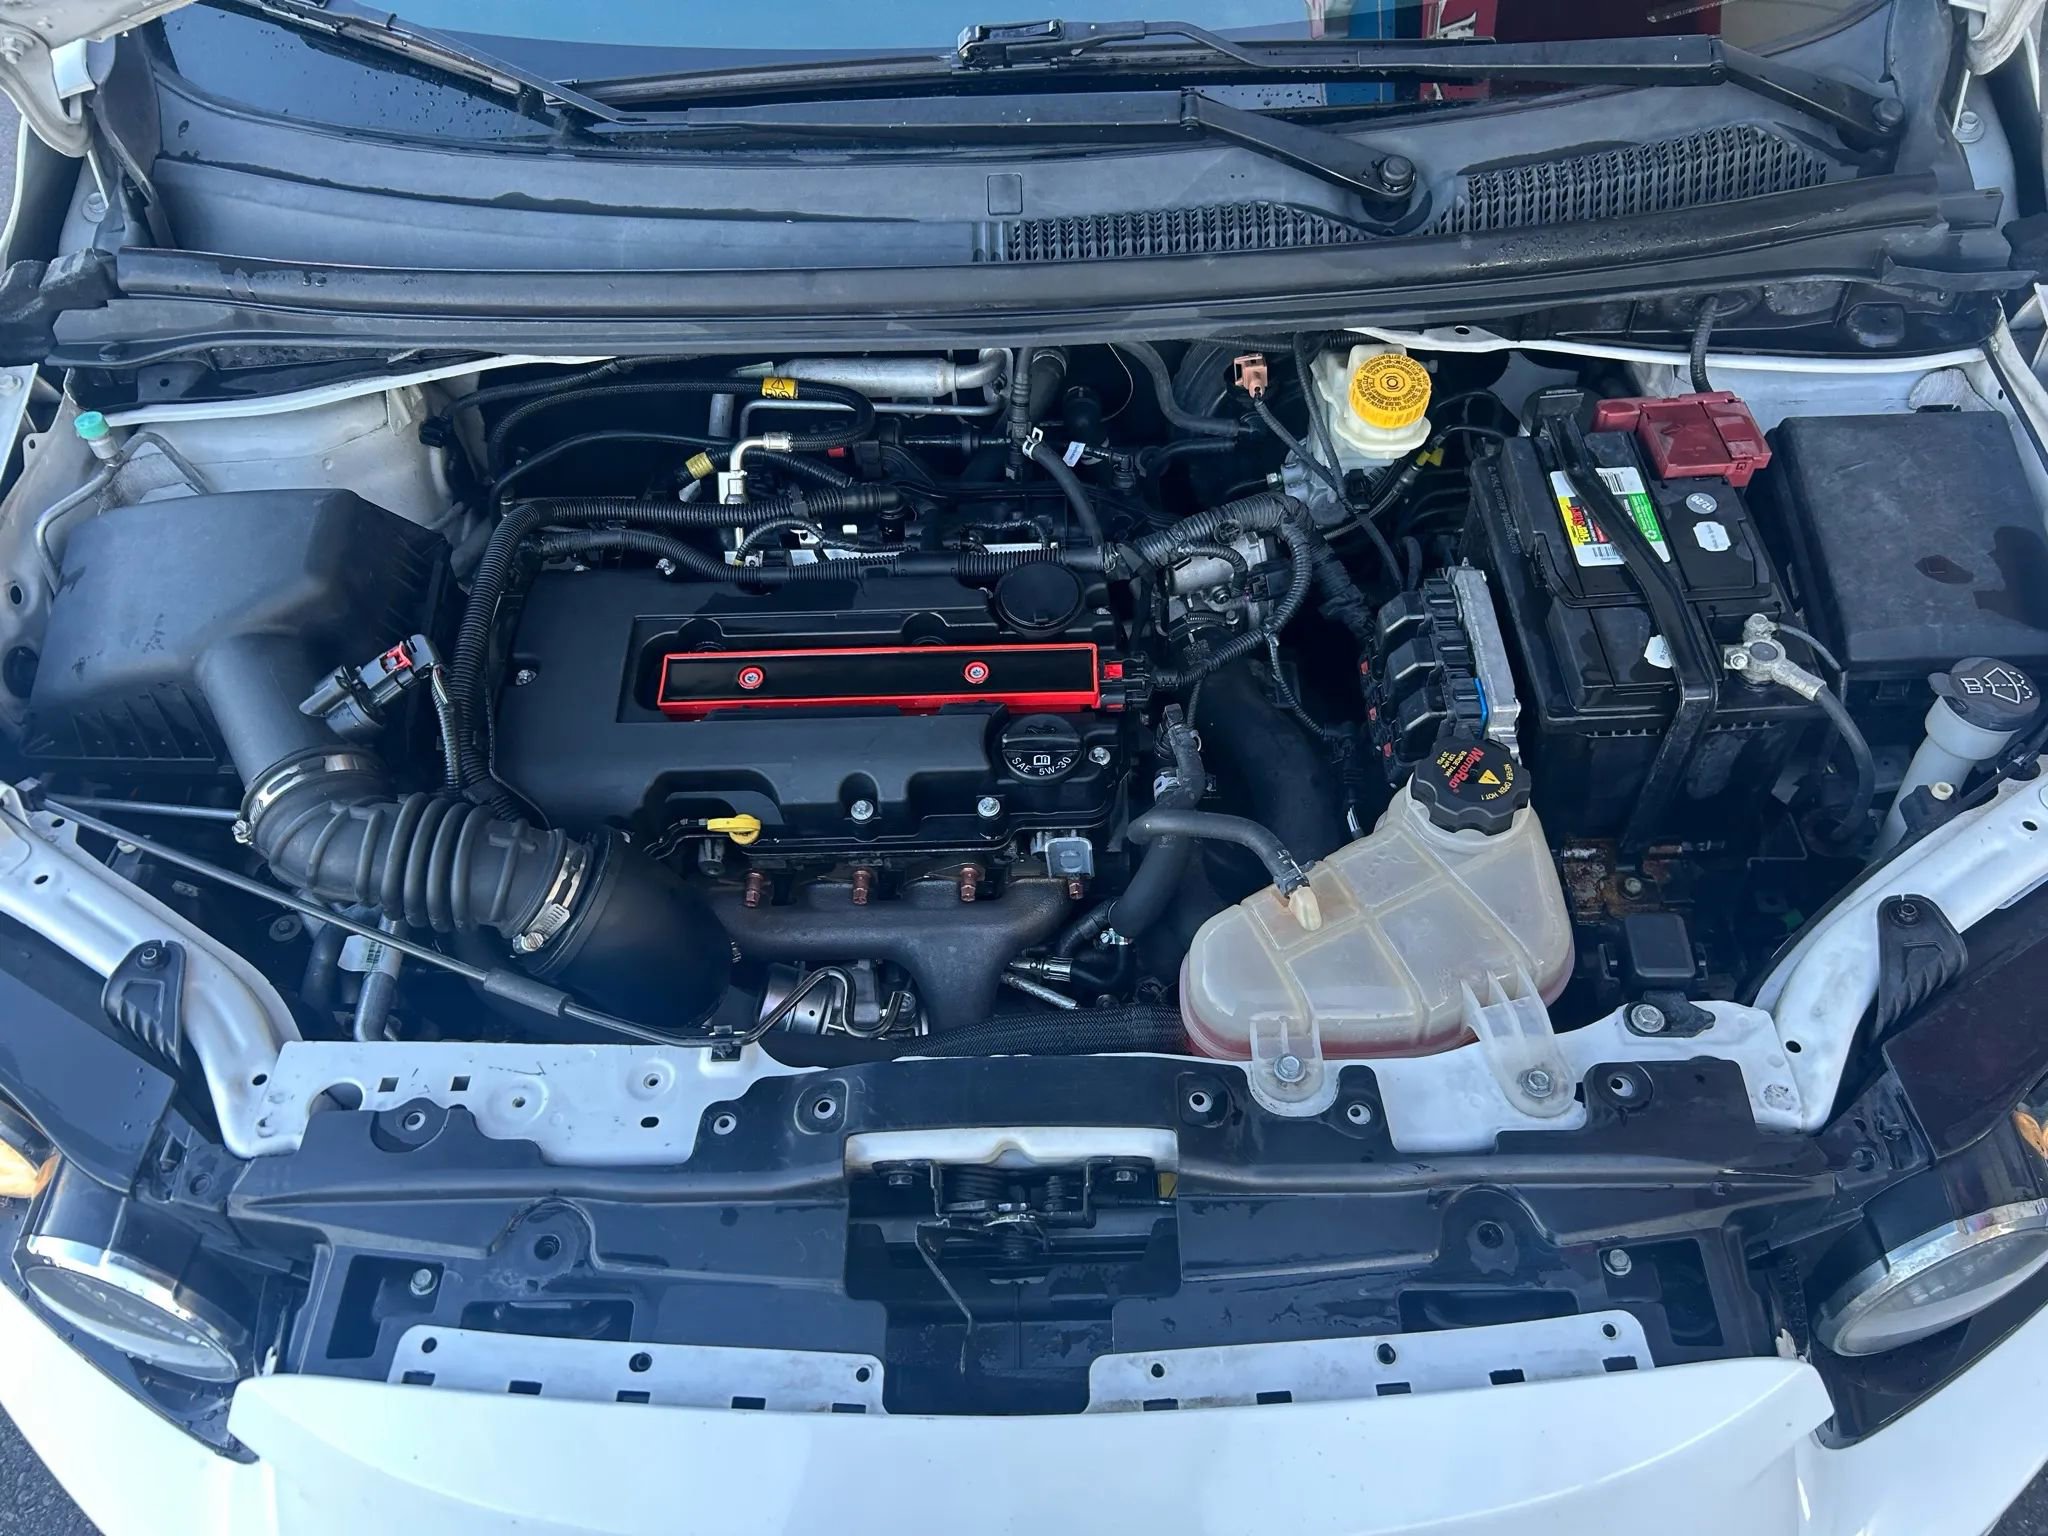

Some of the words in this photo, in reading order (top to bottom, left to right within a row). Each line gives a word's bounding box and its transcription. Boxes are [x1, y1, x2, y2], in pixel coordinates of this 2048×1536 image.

[1691, 495, 1713, 511] 12/20
[1566, 505, 1591, 542] EverStart
[1012, 757, 1032, 773] SAE
[1038, 756, 1072, 776] 5W-30
[1436, 756, 1445, 764] PSI
[1452, 750, 1467, 766] SURGE
[1444, 765, 1456, 777] TANK
[1503, 763, 1514, 781] NEVER
[1485, 791, 1499, 801] HOT
[1498, 781, 1512, 795] OPEN
